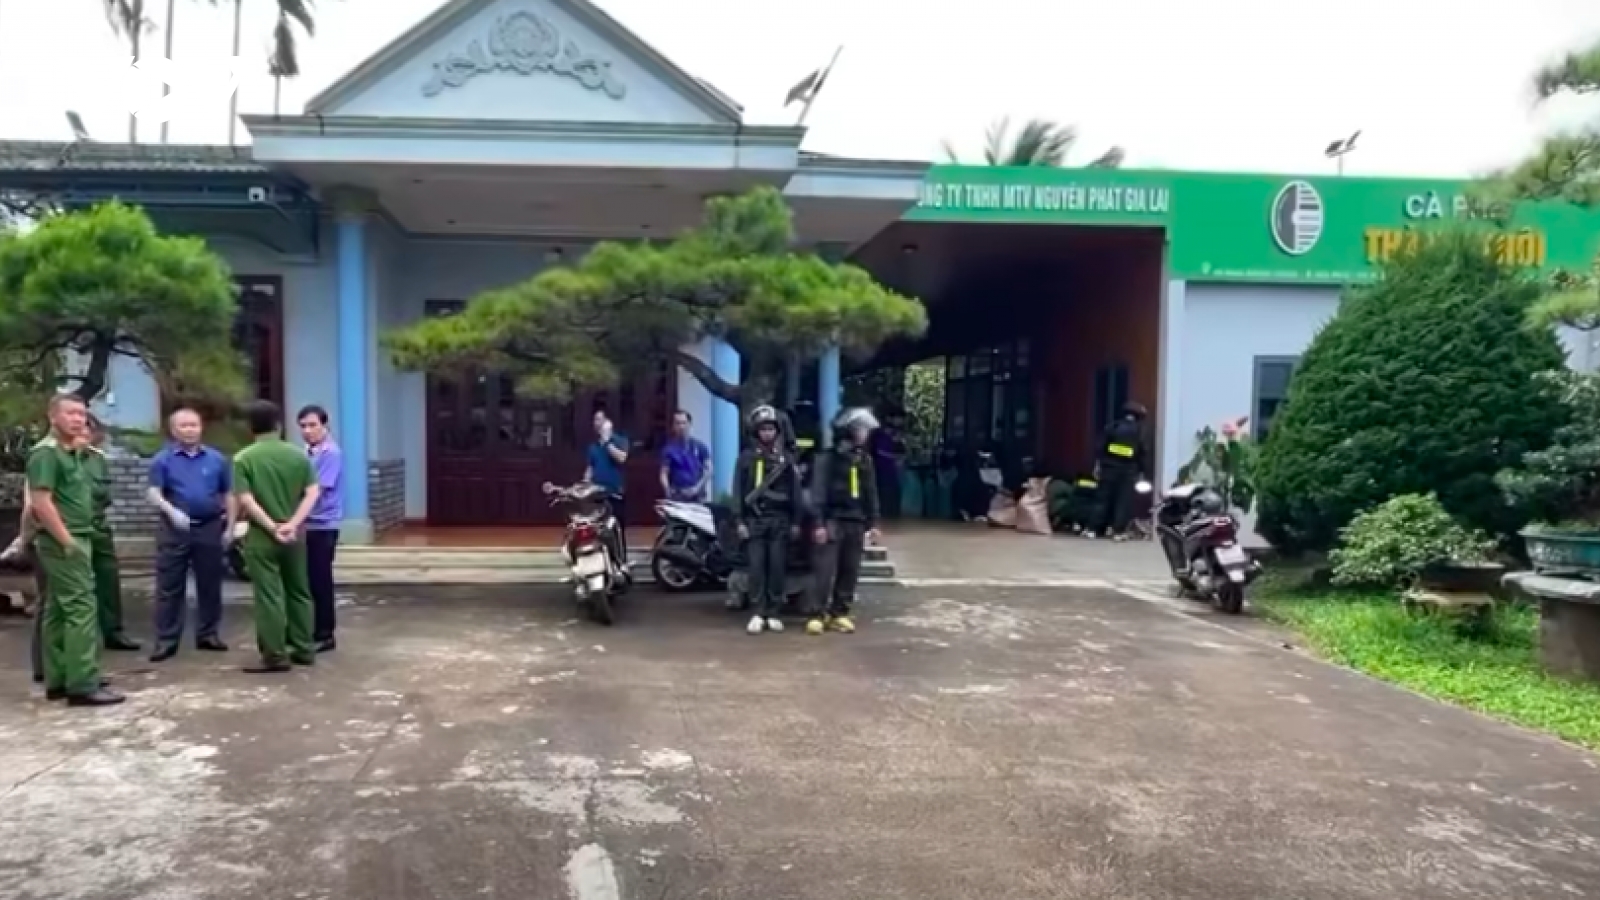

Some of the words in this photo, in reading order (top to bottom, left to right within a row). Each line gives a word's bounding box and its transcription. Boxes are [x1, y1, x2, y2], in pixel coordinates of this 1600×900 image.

[946, 183, 962, 208] TY
[965, 183, 1000, 208] TNHH
[1003, 184, 1031, 209] MTV
[1125, 186, 1146, 212] GIA
[1149, 187, 1170, 212] LAI
[1406, 190, 1443, 218] CÀ
